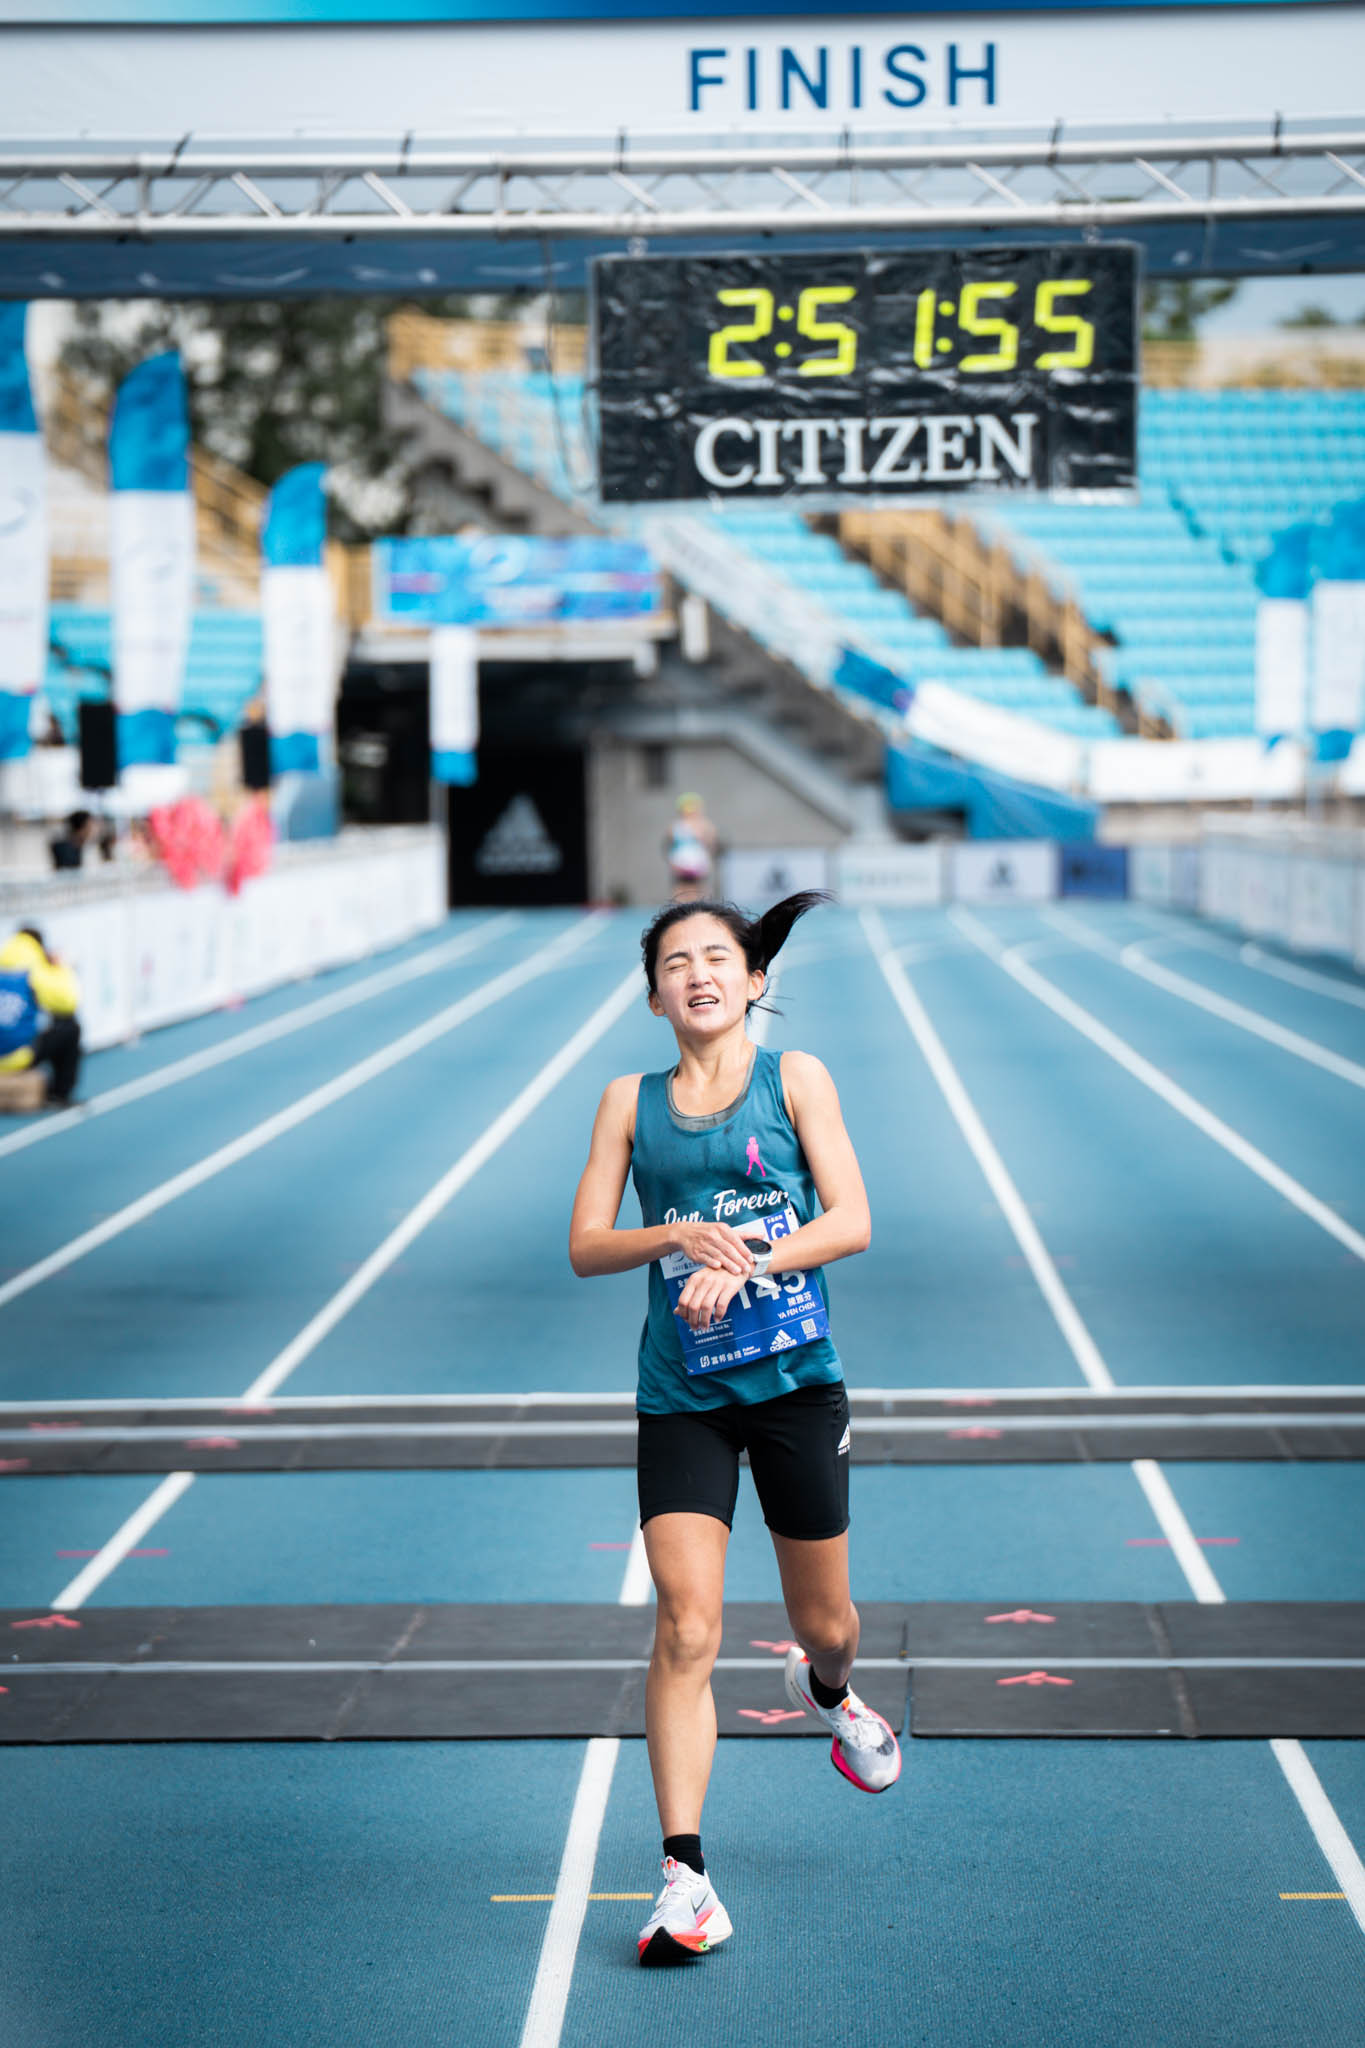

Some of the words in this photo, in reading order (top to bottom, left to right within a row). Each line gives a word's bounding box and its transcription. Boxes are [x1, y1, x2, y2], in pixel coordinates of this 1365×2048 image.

[688, 43, 997, 111] FINISH
[694, 414, 1038, 488] CITIZEN
[712, 1189, 790, 1222] Forever
[786, 1307, 799, 1317] FEN
[799, 1301, 816, 1312] CHEN
